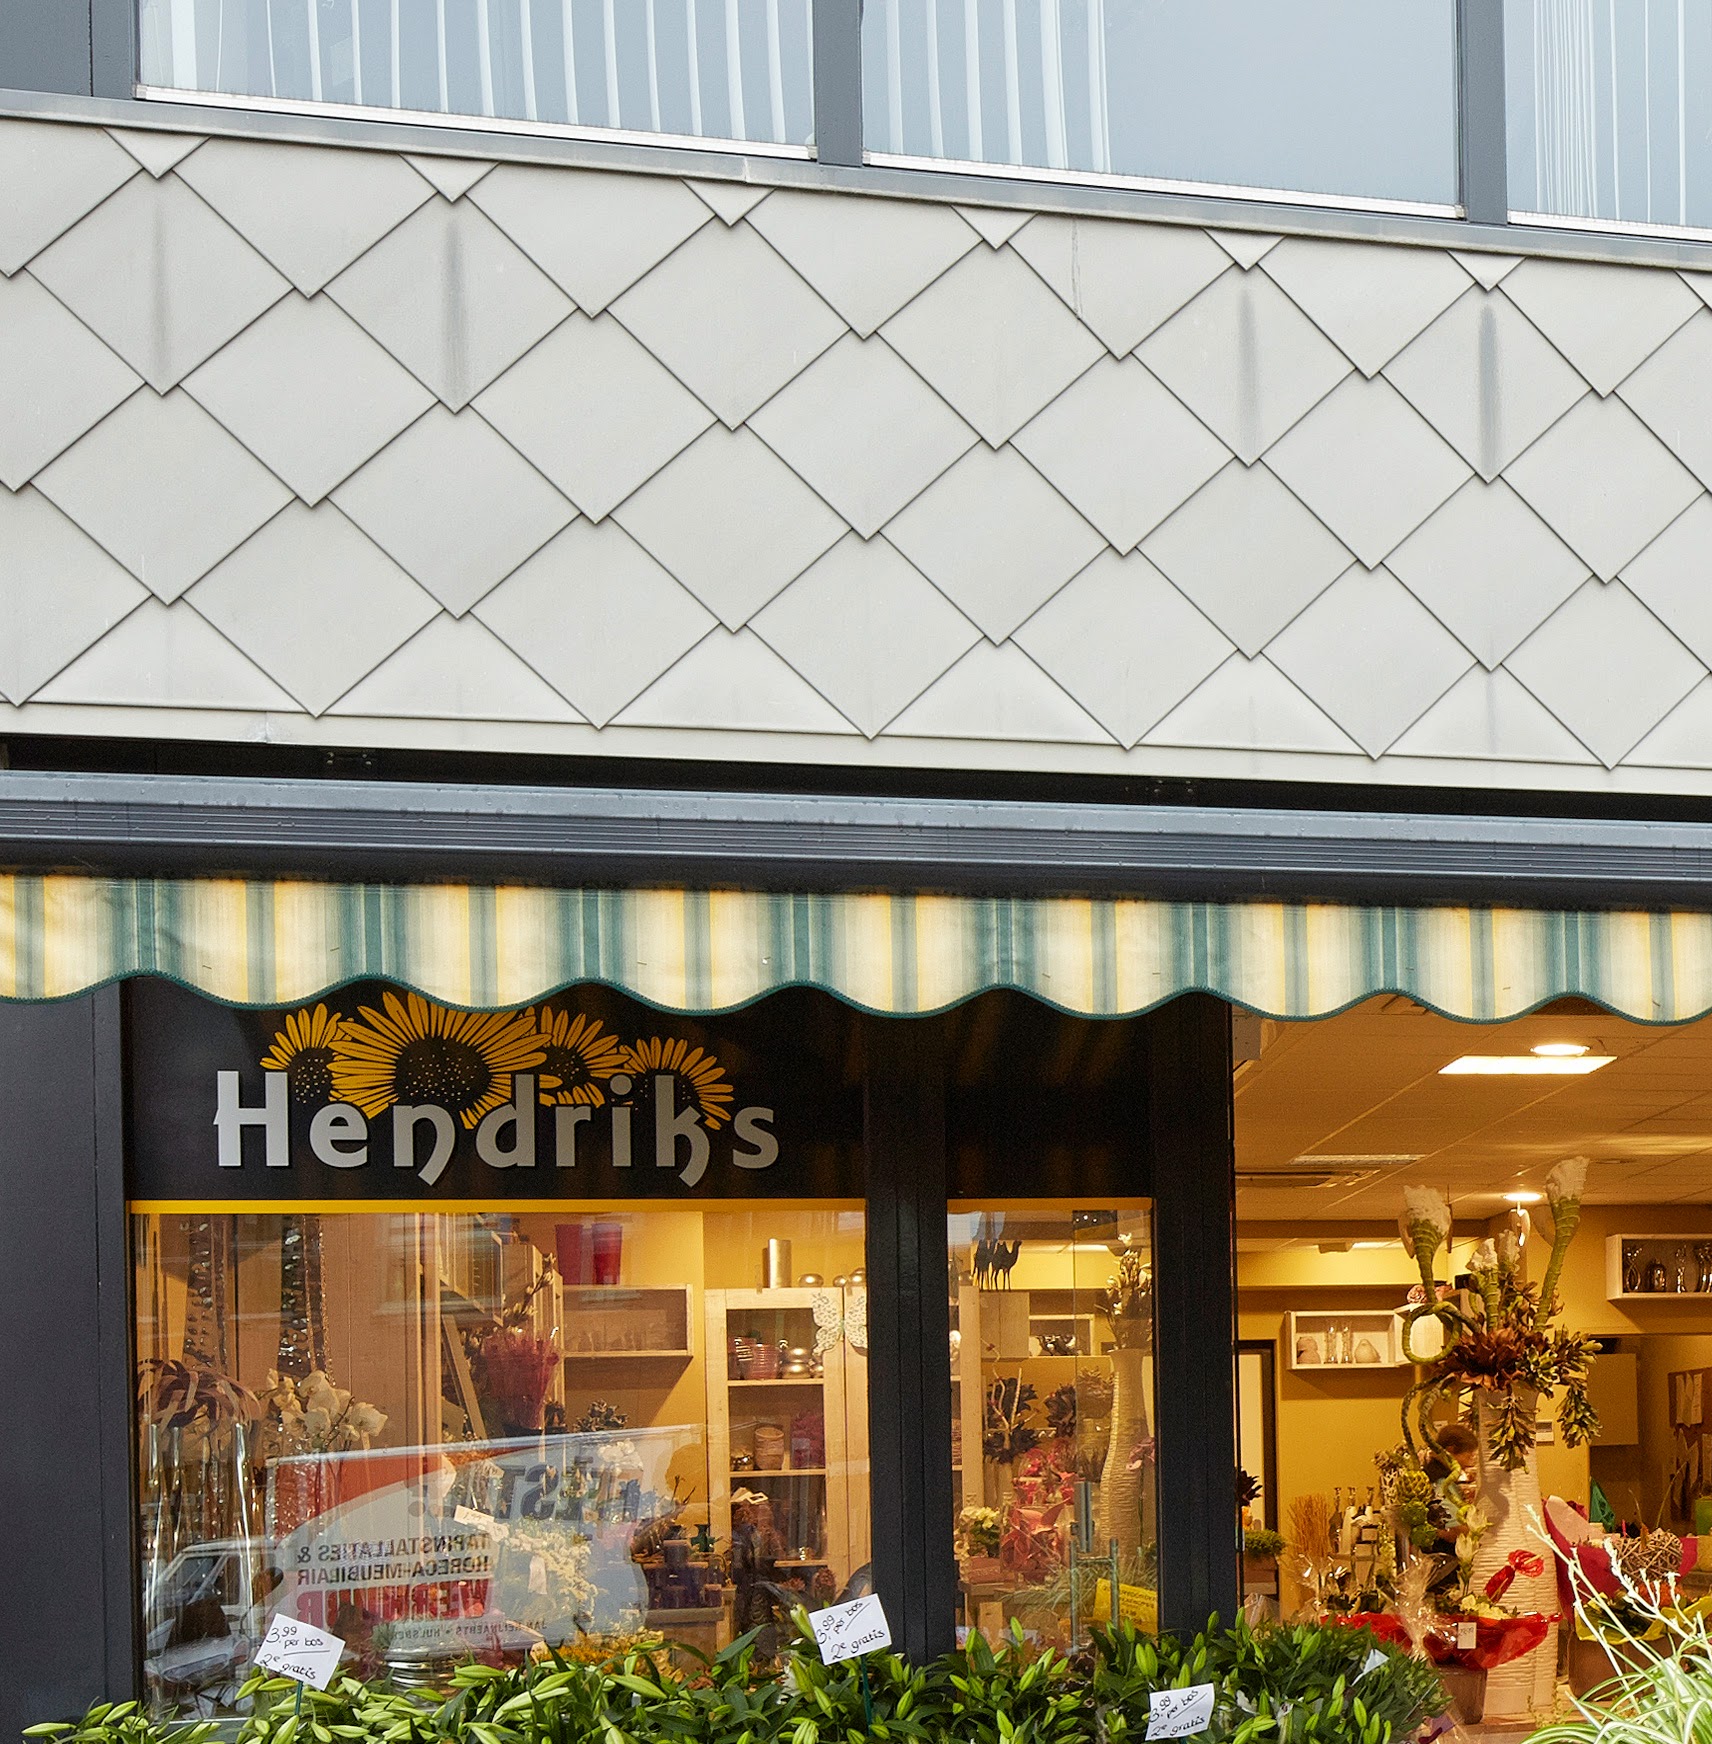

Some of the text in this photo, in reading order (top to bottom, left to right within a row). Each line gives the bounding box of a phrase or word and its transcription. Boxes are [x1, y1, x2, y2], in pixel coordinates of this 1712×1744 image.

[213, 1070, 779, 1187] Hendriks
[845, 1602, 864, 1616] bos
[283, 1639, 300, 1649] per
[304, 1638, 323, 1647] bos
[850, 1629, 886, 1654] gratis
[280, 1663, 316, 1680] gratis
[1180, 1689, 1199, 1706] bos
[1169, 1716, 1206, 1736] gratis
